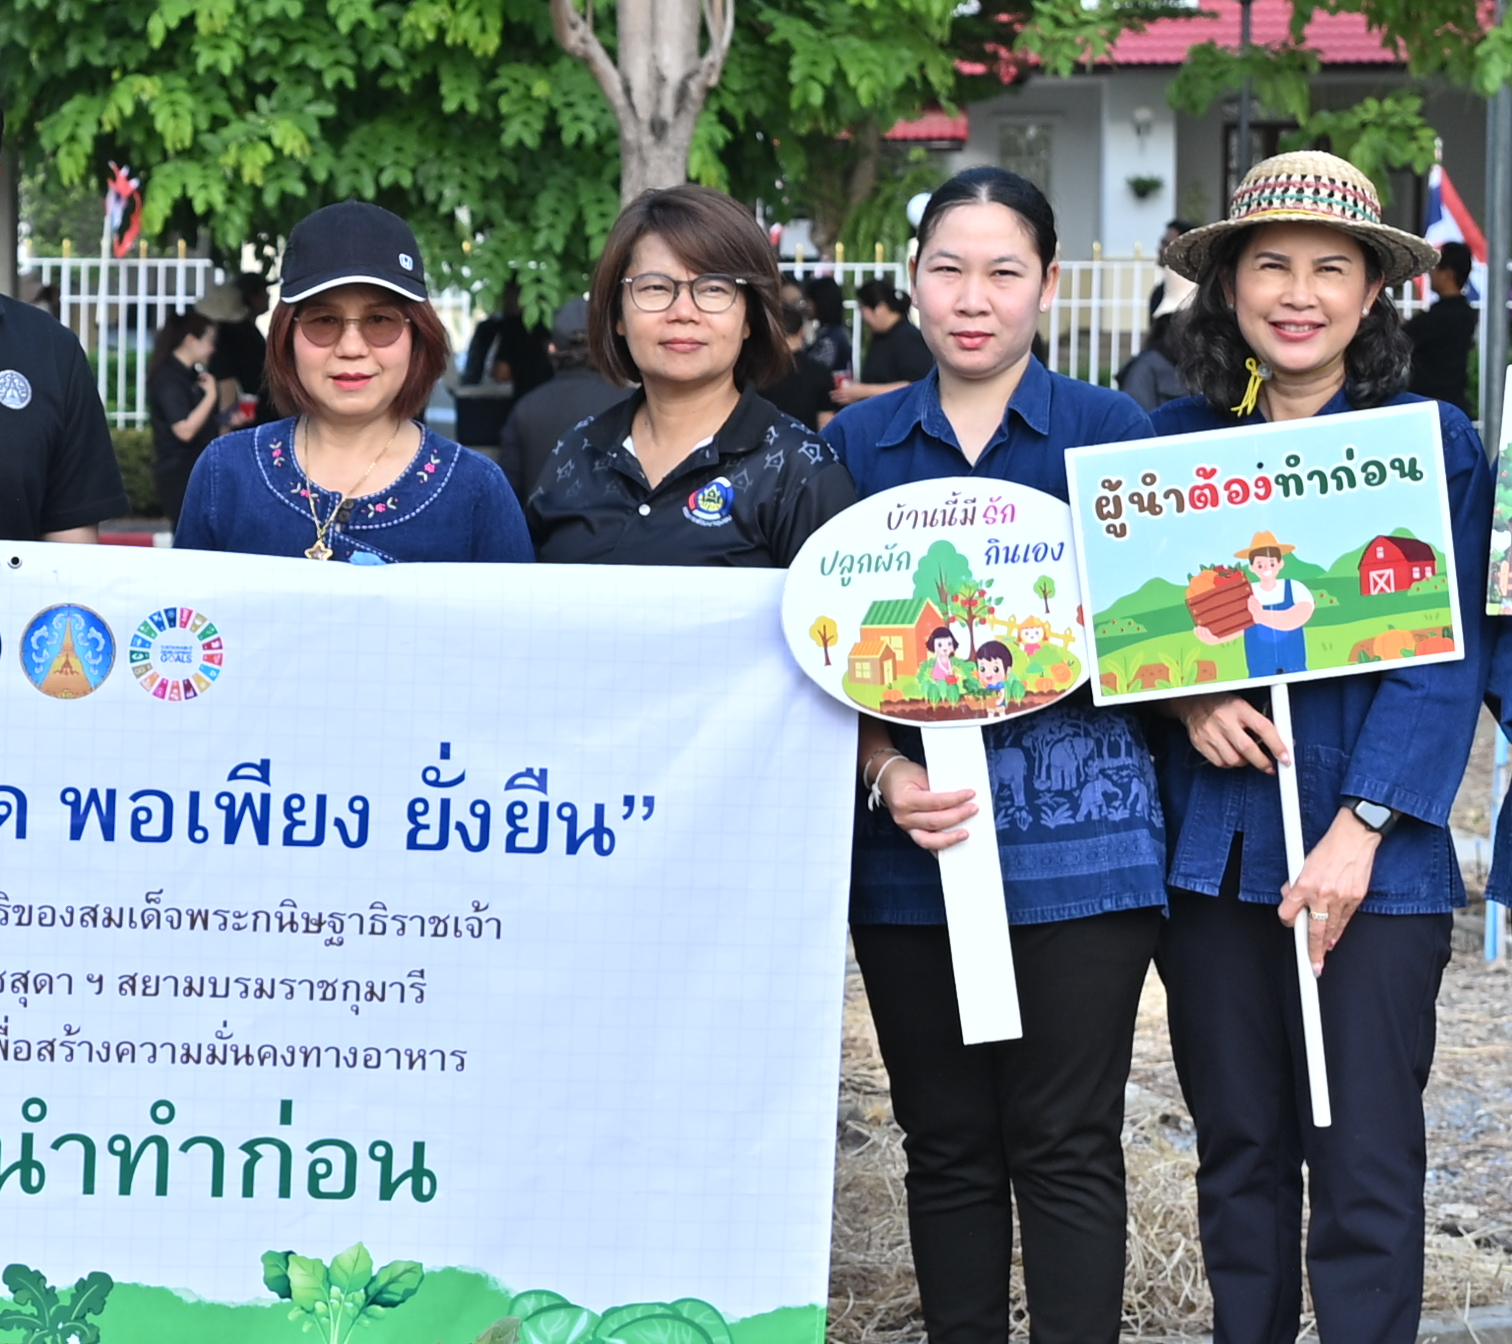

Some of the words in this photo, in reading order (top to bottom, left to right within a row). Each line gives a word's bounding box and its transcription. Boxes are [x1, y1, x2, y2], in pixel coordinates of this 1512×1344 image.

[1095, 448, 1423, 538] ผู้นำต้องทำก่อน
[820, 543, 911, 587] ปลูกผัก
[984, 538, 1064, 565] กินเอง
[60, 758, 370, 850] พอเพียง
[118, 968, 427, 1015] สยามบรมราชกุมารี
